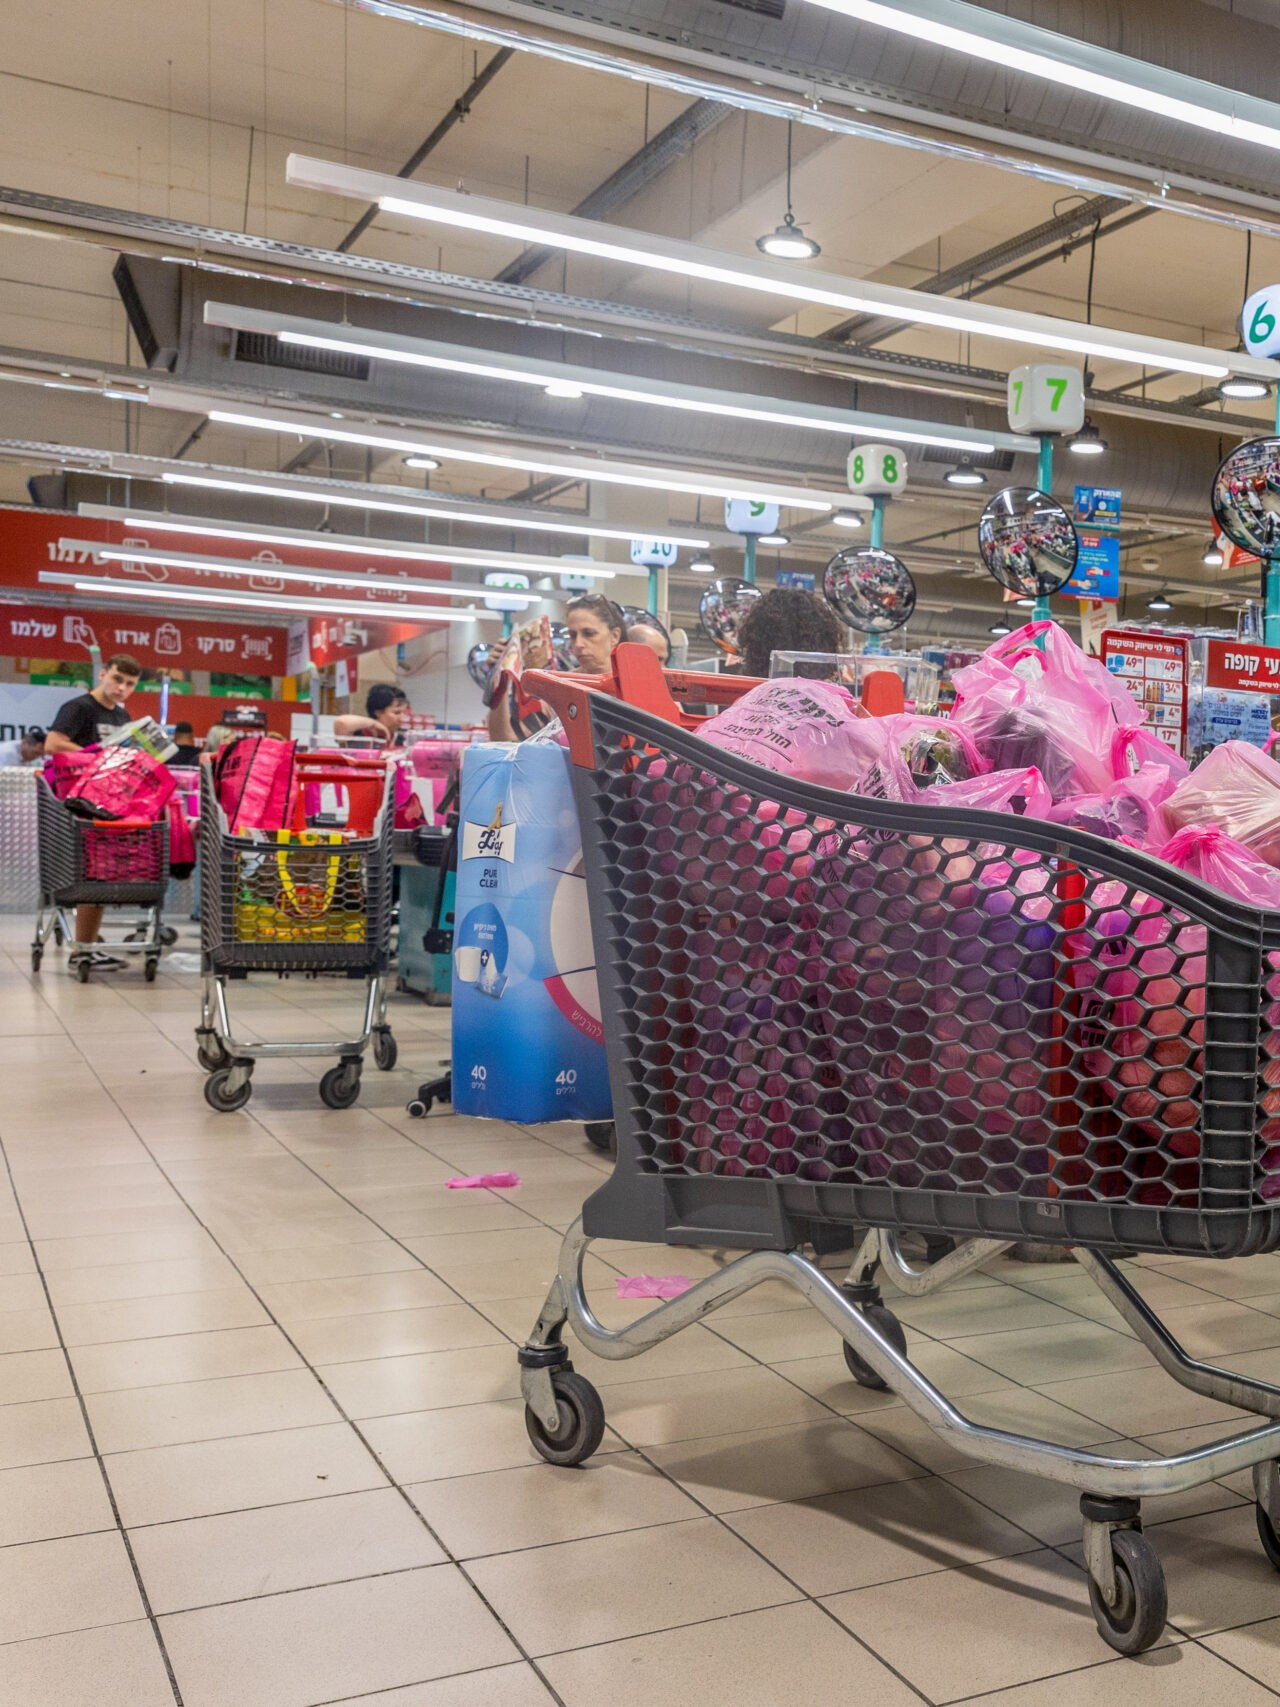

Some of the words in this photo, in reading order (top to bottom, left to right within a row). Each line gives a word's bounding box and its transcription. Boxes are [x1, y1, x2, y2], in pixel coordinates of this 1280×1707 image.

[1249, 300, 1276, 344] 6
[1045, 377, 1068, 412] 7
[853, 454, 864, 485] 8
[882, 454, 898, 483] 8
[10, 619, 57, 638] שלמו
[114, 629, 150, 646] ארזו
[196, 635, 236, 654] סרקו
[1224, 652, 1260, 676] קופה
[471, 1065, 487, 1081] 40
[555, 1069, 577, 1085] 40
